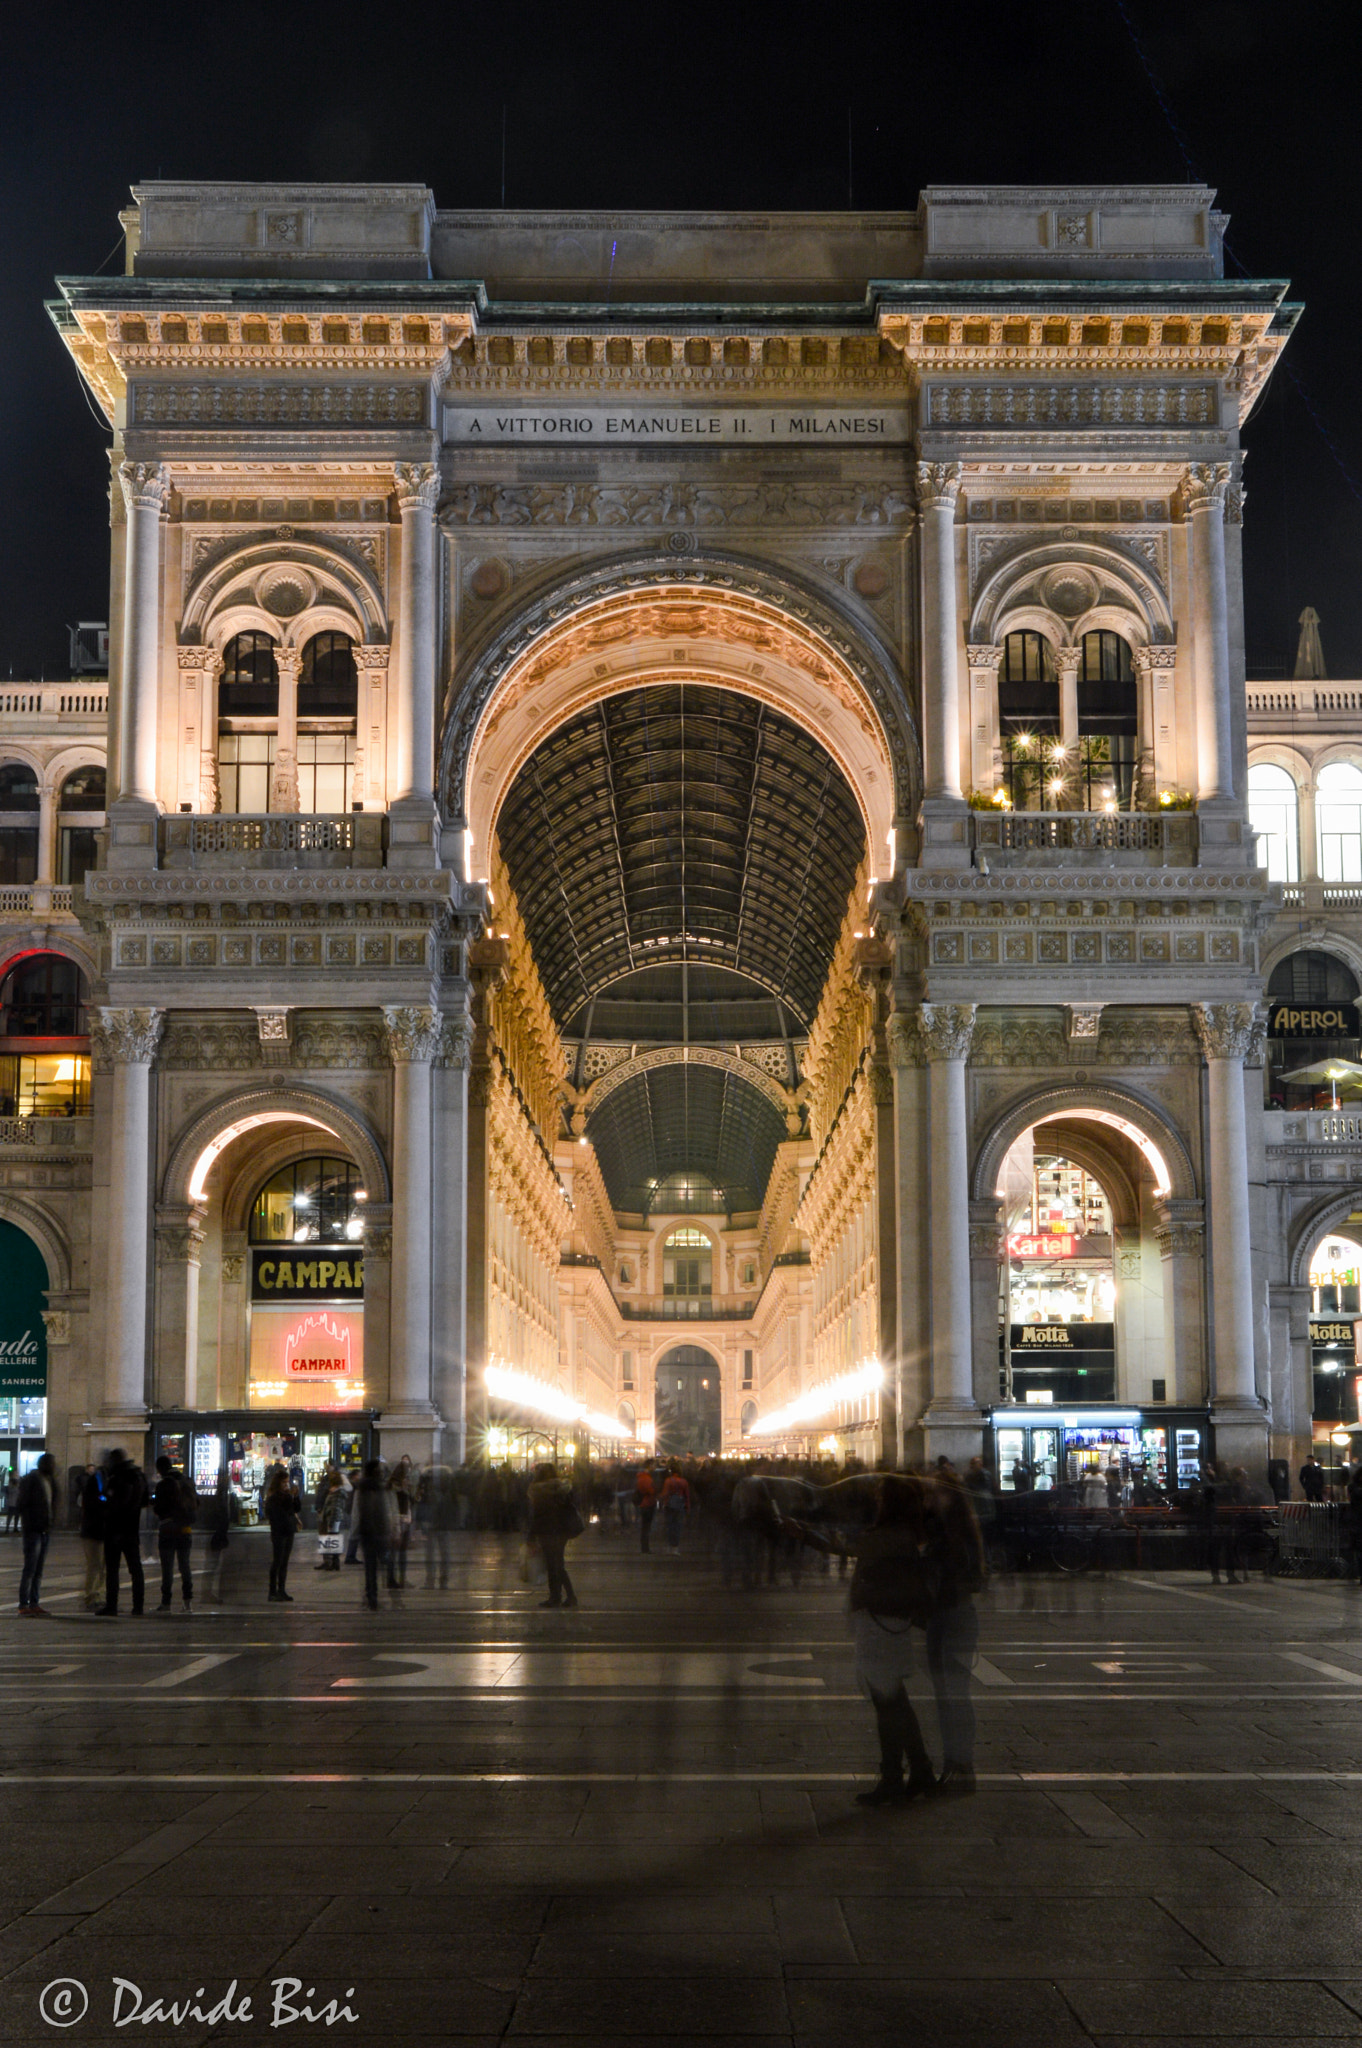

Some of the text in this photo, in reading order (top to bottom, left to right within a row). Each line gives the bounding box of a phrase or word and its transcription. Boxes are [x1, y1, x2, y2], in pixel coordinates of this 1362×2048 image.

[469, 418, 482, 433] A
[496, 418, 593, 433] VITTORIO
[605, 418, 721, 433] EMANUELE
[770, 418, 776, 433] I
[788, 418, 885, 433] MILANESI
[1274, 1007, 1348, 1029] APEROL
[1008, 1235, 1071, 1255] Kartell
[1021, 1326, 1070, 1343] Motta
[291, 1359, 346, 1371] CAMPARI
